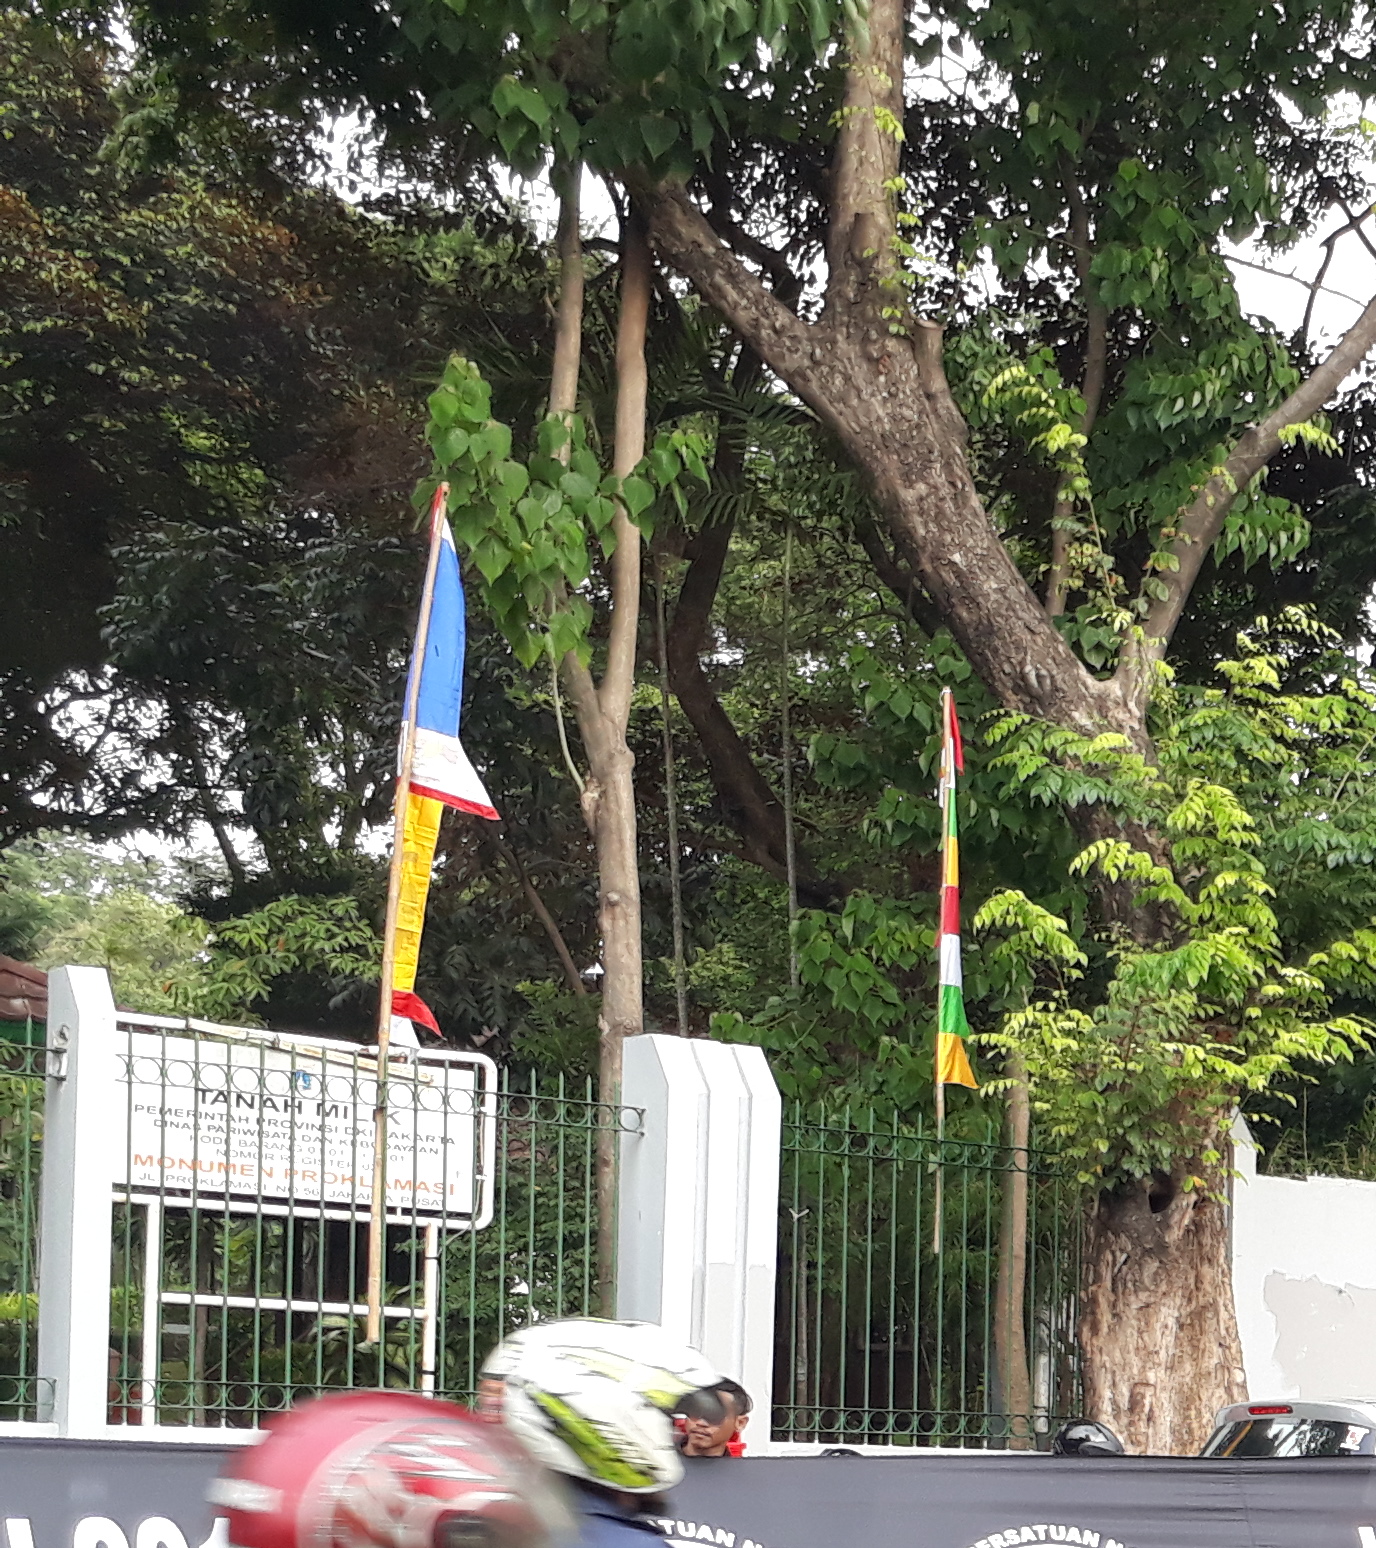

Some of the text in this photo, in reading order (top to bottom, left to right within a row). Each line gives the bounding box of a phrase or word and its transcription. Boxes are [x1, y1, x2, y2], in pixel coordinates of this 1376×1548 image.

[195, 1087, 303, 1116] TANAH
[134, 1103, 250, 1125] PEMERINTAH
[256, 1117, 339, 1134] PROVINSI
[383, 1131, 455, 1145] AKARTA
[301, 1134, 333, 1146] DAN
[134, 1153, 274, 1179] MONUMEN
